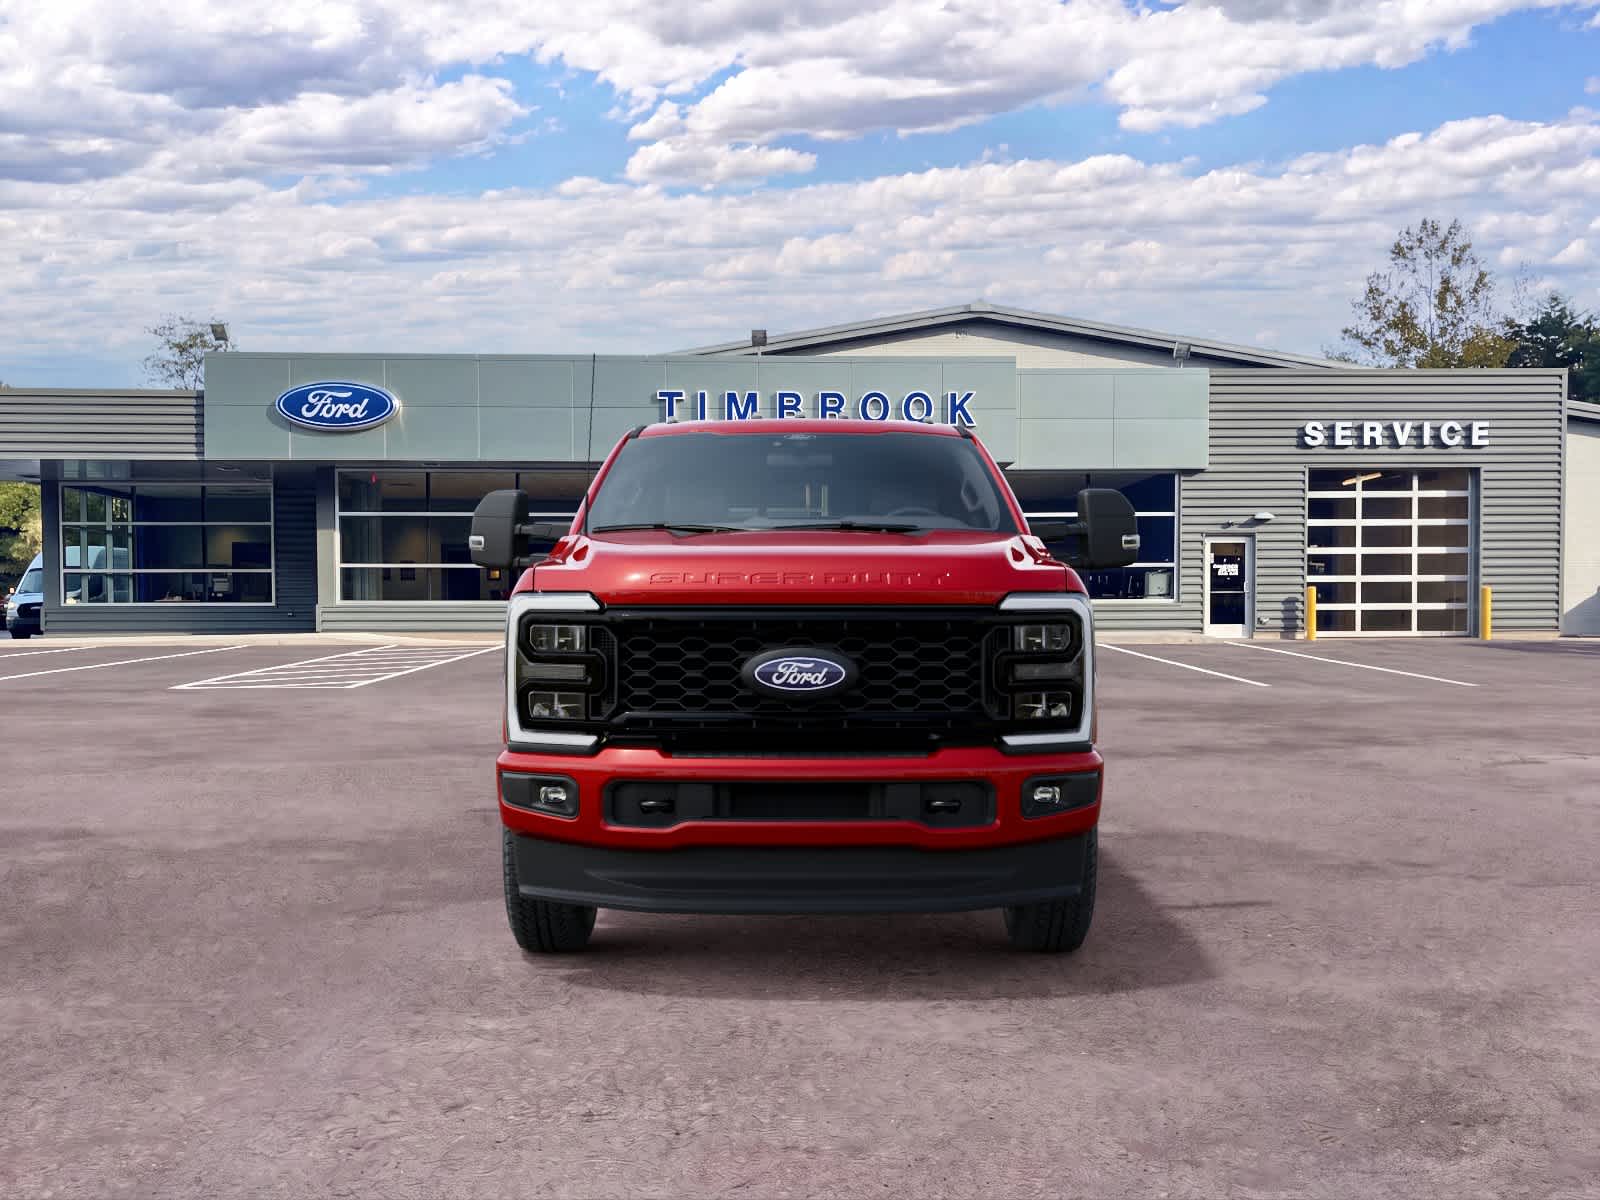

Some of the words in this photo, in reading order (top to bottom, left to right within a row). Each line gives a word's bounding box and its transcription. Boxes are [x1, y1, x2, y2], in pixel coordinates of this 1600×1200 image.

[301, 390, 369, 418] Ford
[657, 391, 976, 426] TIMBROOK
[1304, 421, 1490, 446] SERVICE
[649, 572, 814, 585] SUPER
[771, 661, 828, 684] Ford
